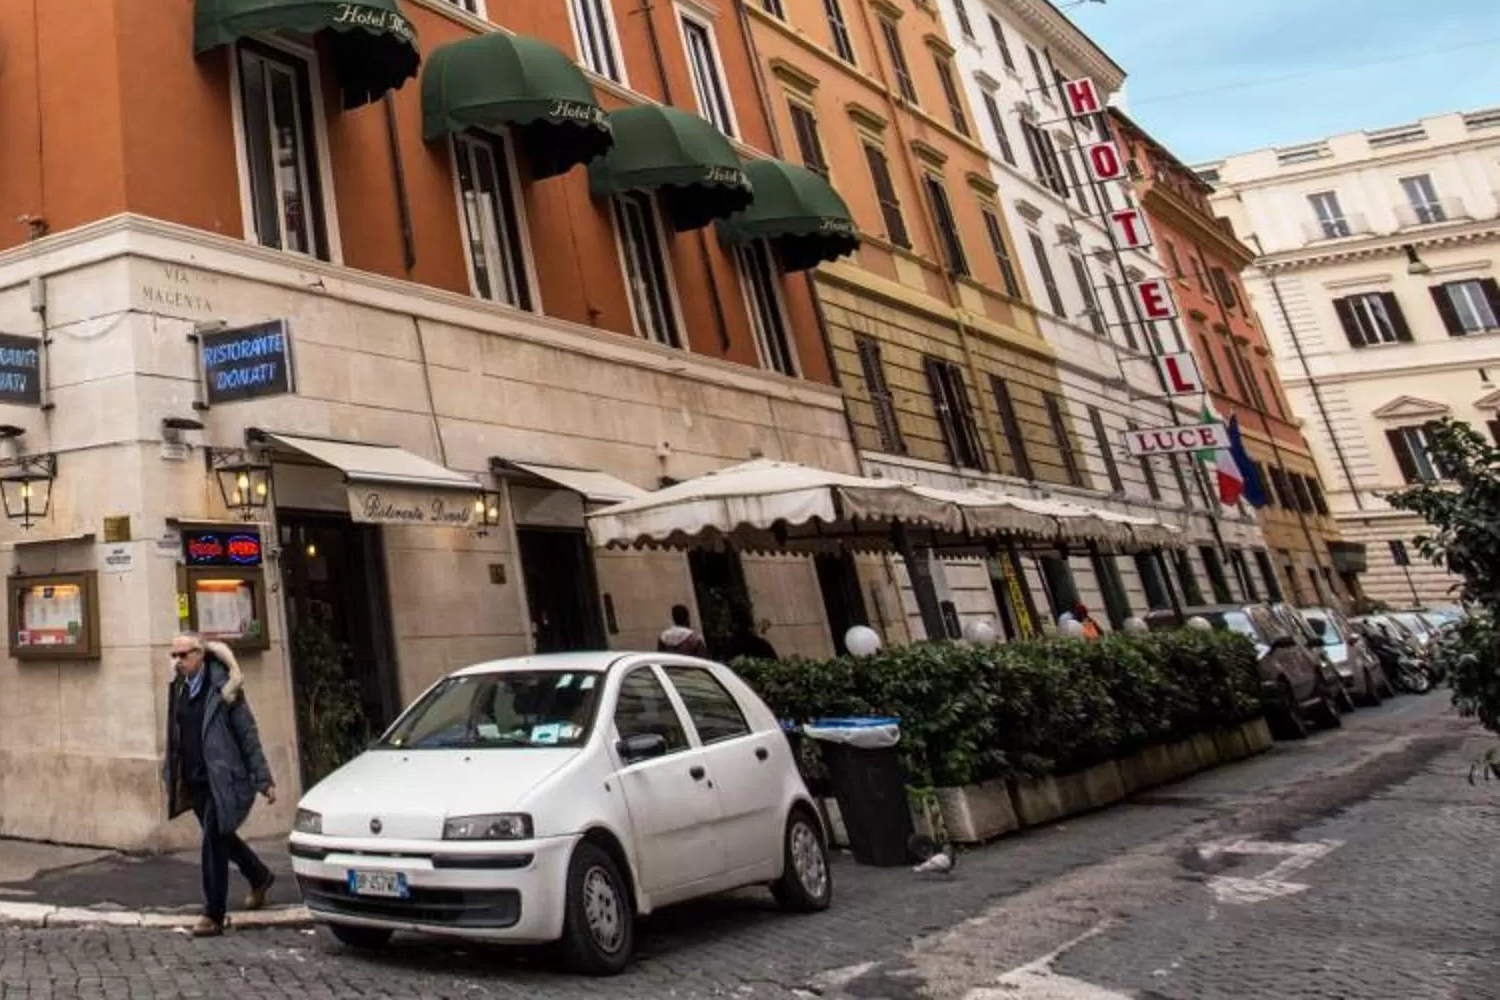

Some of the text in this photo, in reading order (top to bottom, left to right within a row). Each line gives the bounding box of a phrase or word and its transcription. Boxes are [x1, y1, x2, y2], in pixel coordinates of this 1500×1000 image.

[334, 3, 388, 27] Hotel
[1066, 79, 1196, 394] HOTEL
[163, 266, 189, 285] VIA
[142, 284, 213, 313] MAGENTA
[203, 333, 284, 368] RISTORANTE
[216, 361, 277, 392] DONATI
[1135, 426, 1218, 452] LUCE
[364, 493, 424, 521] Ristorante
